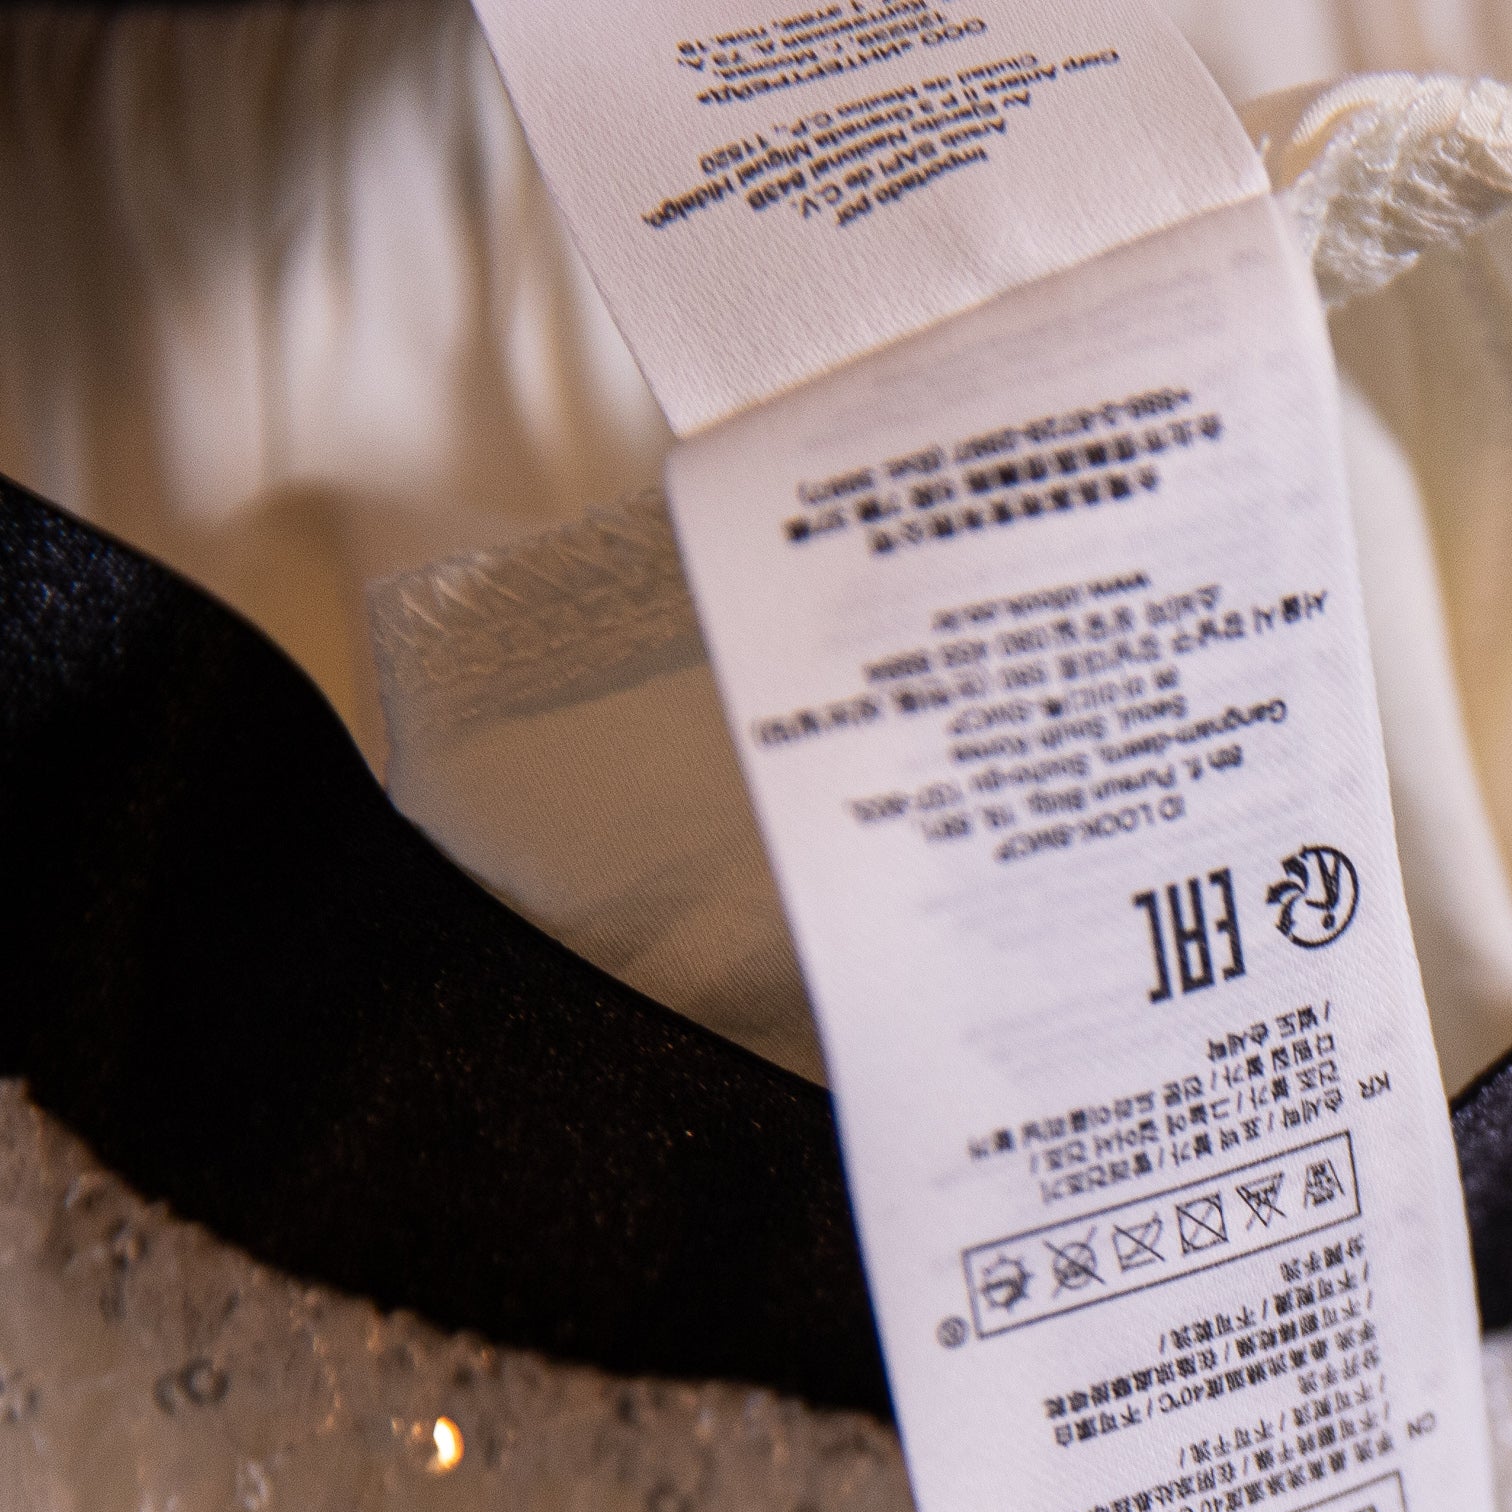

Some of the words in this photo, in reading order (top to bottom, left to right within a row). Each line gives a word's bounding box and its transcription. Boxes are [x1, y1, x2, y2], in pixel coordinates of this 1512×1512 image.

[734, 140, 814, 188] Miguel
[843, 165, 876, 190] de
[873, 146, 989, 206] Importado
[641, 175, 736, 229] Hidalgo,
[790, 182, 844, 220] C.V.
[835, 193, 873, 228] por
[1131, 866, 1247, 1004] EAC
[1357, 1070, 1391, 1100] KR
[1406, 1411, 1435, 1439] CN
